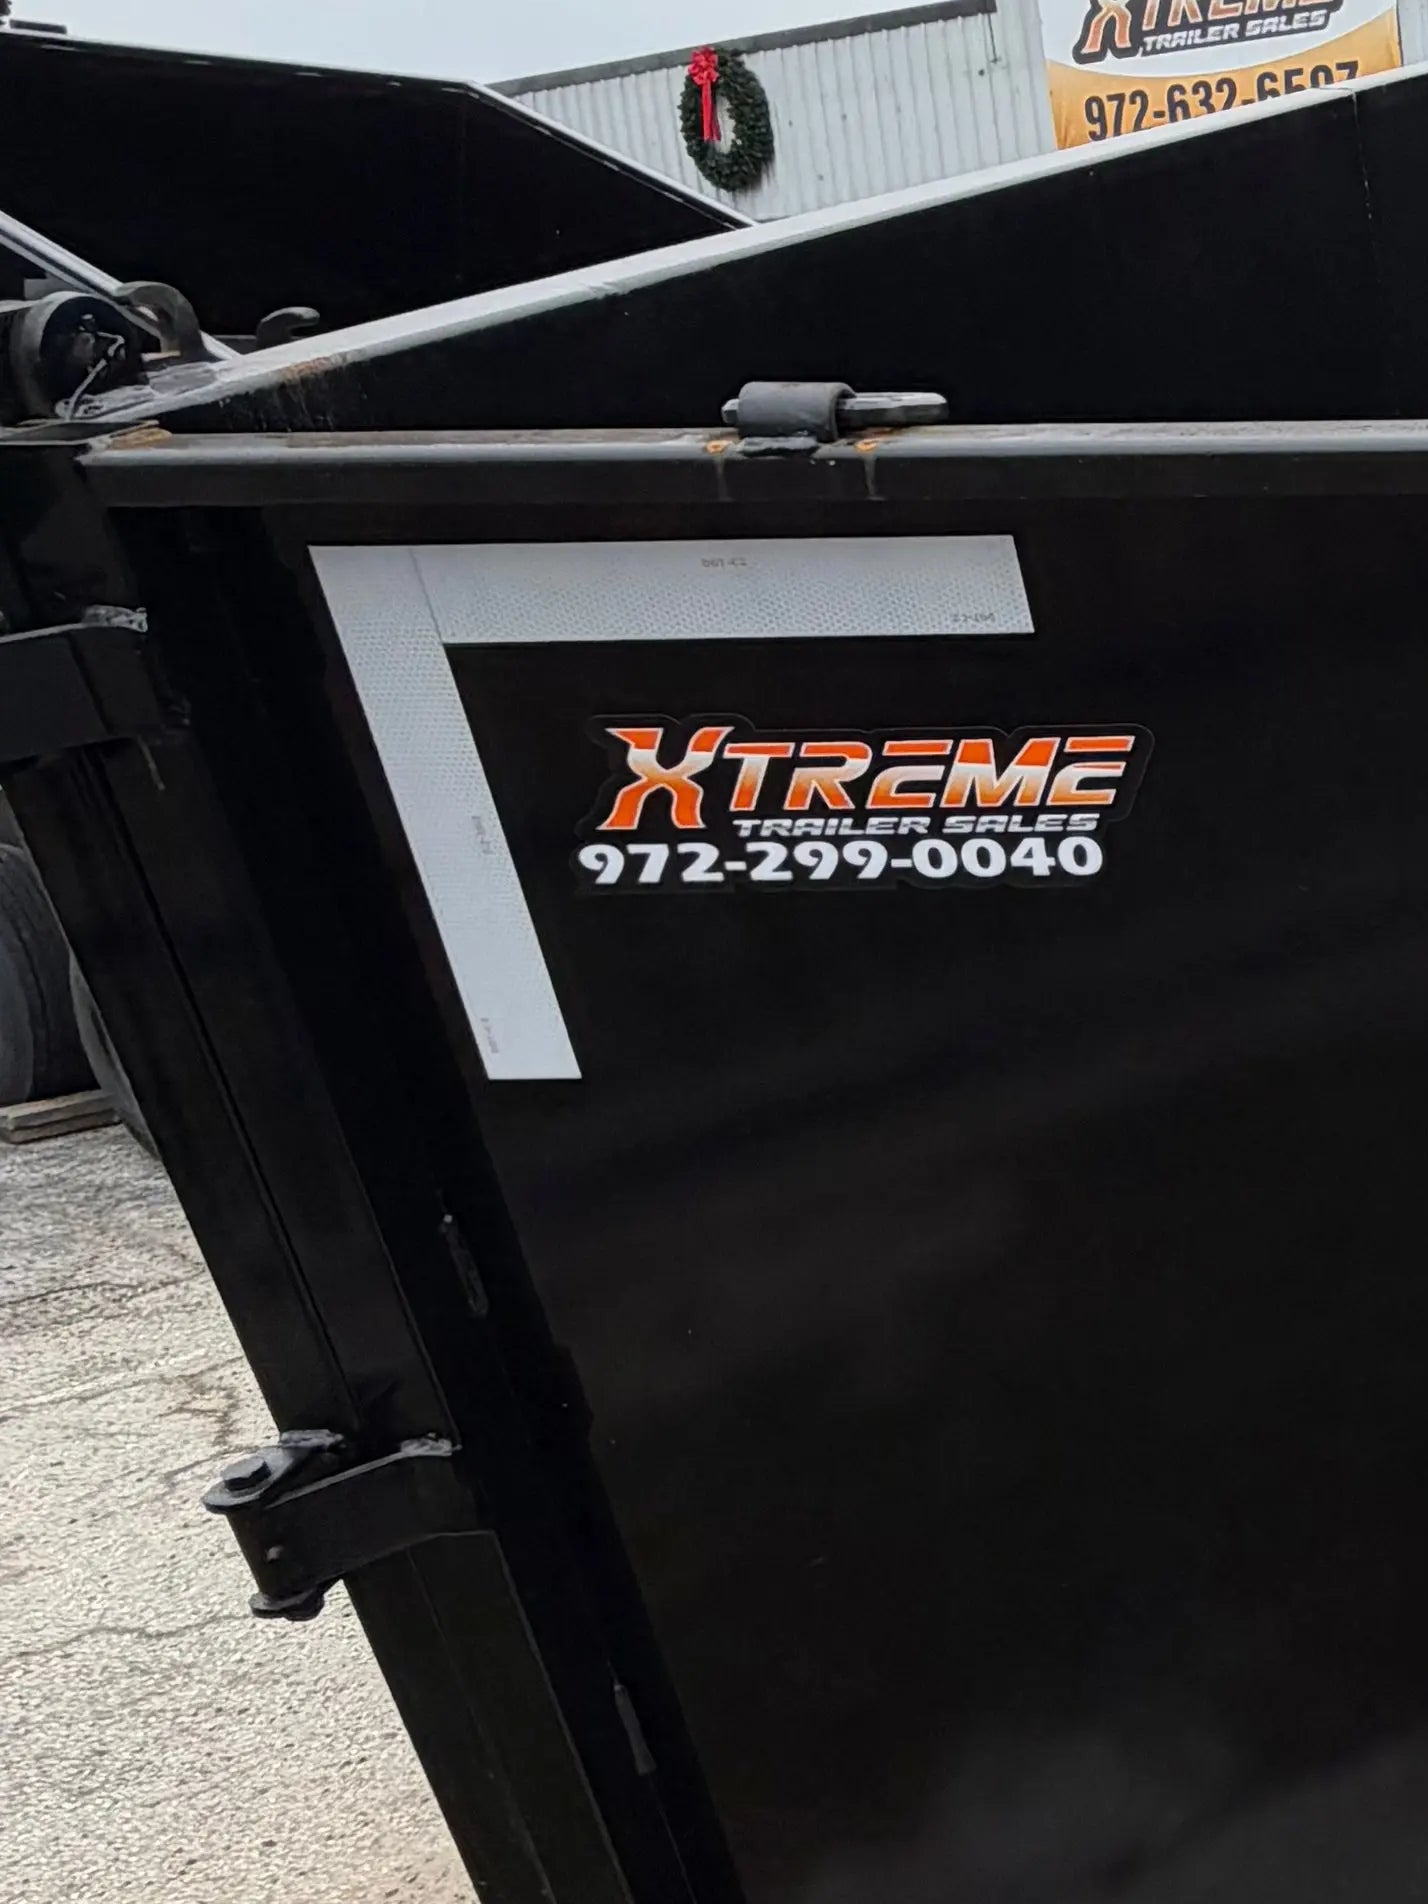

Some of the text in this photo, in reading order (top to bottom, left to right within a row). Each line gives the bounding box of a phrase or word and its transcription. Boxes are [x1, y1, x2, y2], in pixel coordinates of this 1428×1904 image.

[1142, 10, 1329, 53] TRAILER SALES
[595, 726, 1136, 831] XTREME
[731, 812, 1100, 838] TRAILER SALES
[577, 837, 1104, 885] 972-299-0040
